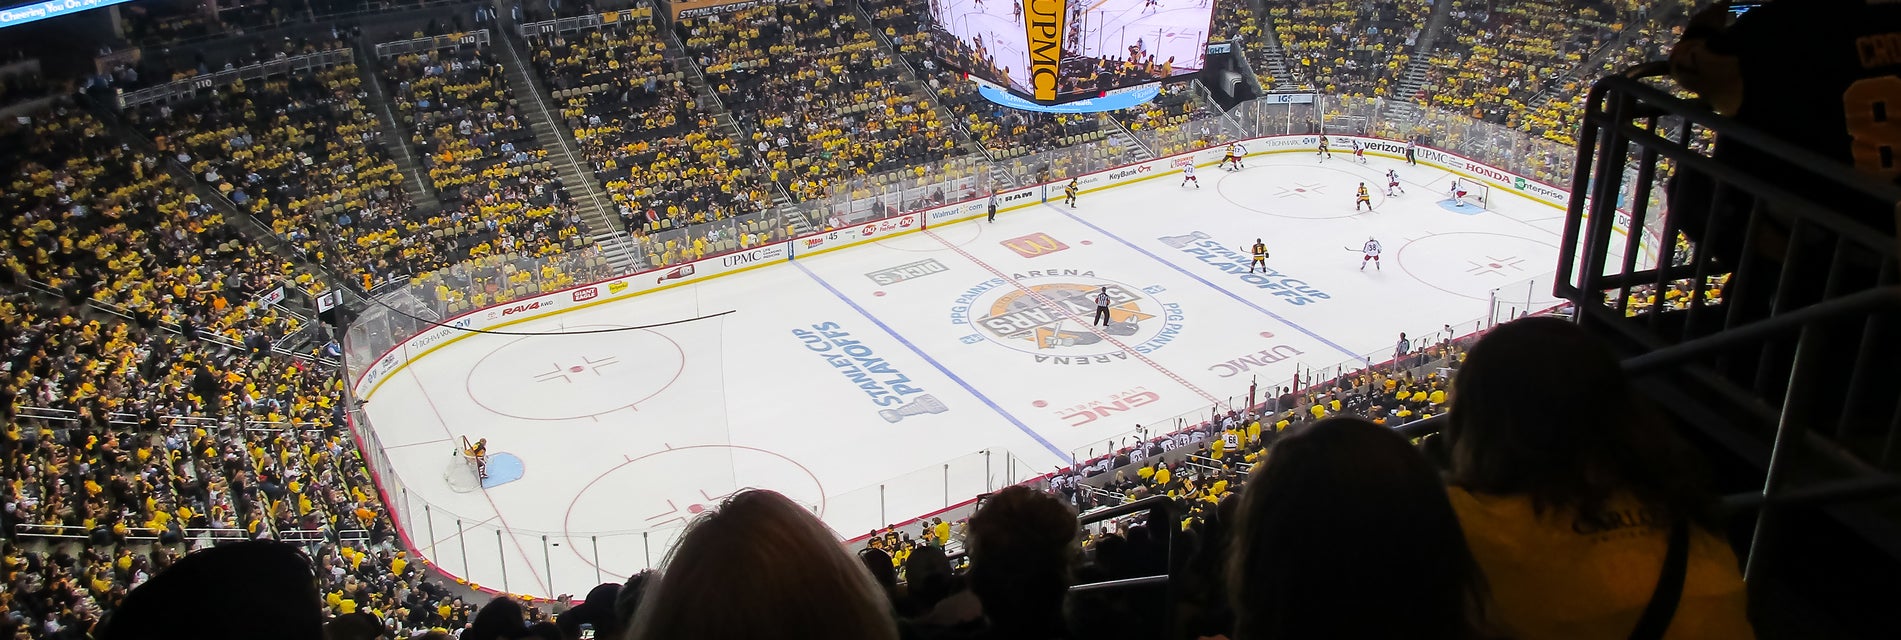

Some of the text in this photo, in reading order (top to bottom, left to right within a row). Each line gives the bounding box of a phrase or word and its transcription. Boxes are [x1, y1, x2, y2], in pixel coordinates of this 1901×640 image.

[0, 8, 46, 22] Cheering
[45, 2, 64, 13] You
[65, 0, 82, 9] On
[680, 5, 725, 19] STANLEY
[725, 2, 745, 13] CUP
[541, 24, 554, 33] 111
[460, 35, 475, 44] 110
[1032, 0, 1056, 91] UPMC
[195, 79, 212, 89] 110
[1364, 141, 1405, 155] verizon
[1417, 148, 1449, 164] UPMC
[1109, 168, 1137, 181] KeyBank
[1465, 163, 1512, 184] HONDA
[1005, 191, 1033, 202] RAM
[932, 207, 960, 219] Walmart
[723, 250, 762, 268] UPMC
[1013, 268, 1097, 280] ARENA
[1181, 247, 1316, 306] PLAYOFFS
[574, 288, 596, 297] GIANT
[575, 292, 597, 301] EAGLE
[955, 276, 1006, 304] PAINTS
[1280, 279, 1331, 300] CUP
[502, 301, 540, 317] RAV4
[540, 300, 554, 308] AWD
[1135, 322, 1184, 354] PAINTS
[811, 321, 925, 396] PLAYOFFS
[1034, 351, 1128, 365] ARENA
[1207, 344, 1306, 379] UPMC
[791, 328, 904, 408] STANLEY CUP
[1061, 391, 1161, 427] GNC
